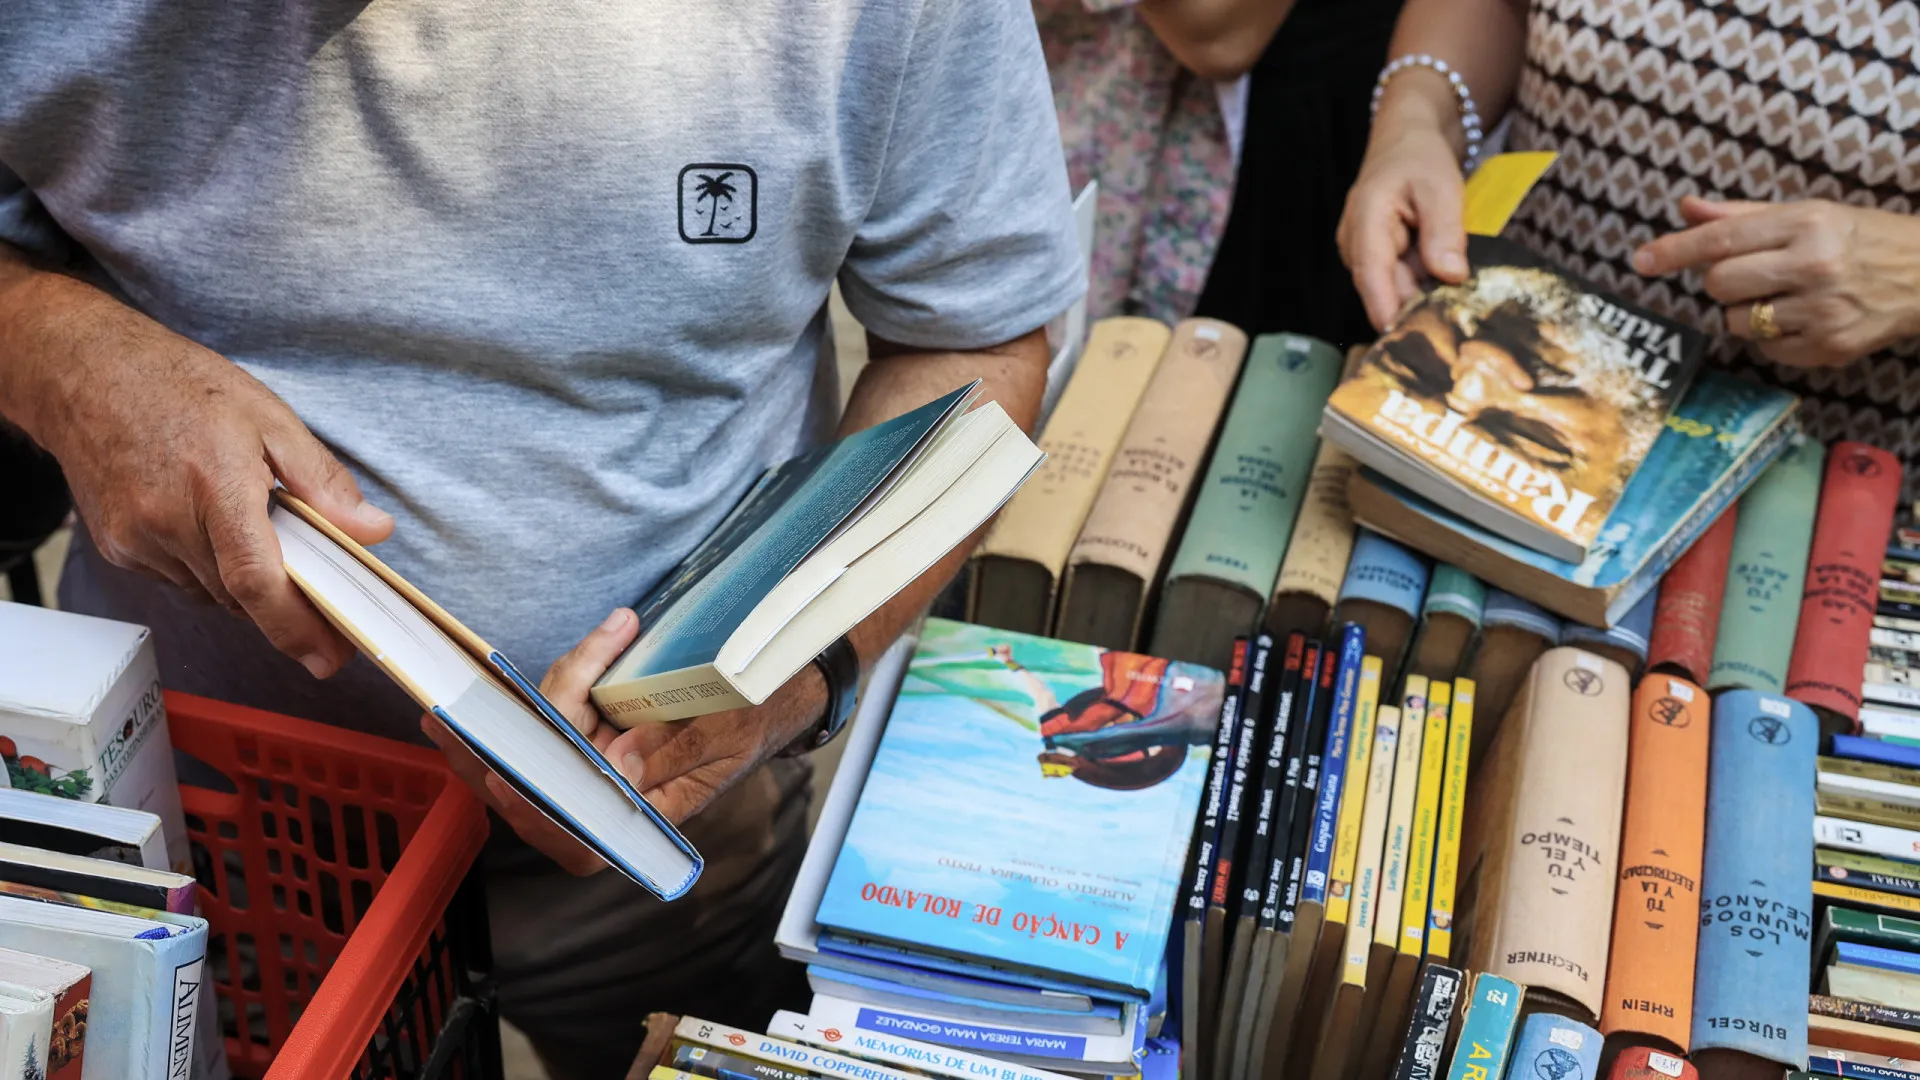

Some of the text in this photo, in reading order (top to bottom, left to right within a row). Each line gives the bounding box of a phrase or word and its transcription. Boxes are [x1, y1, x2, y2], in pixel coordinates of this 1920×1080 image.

[1580, 293, 1684, 361] Vidas
[1376, 389, 1598, 535] Rampa
[648, 687, 695, 707] ALLENDE
[689, 681, 730, 699] ISABEL
[1312, 818, 1331, 854] Gaspar
[1322, 772, 1340, 812] Mariana
[1521, 832, 1602, 864] TIEMPO
[1542, 846, 1587, 872] Y EL
[938, 856, 1136, 902] ALBERTO OLIVEIRA PINTO
[1642, 881, 1676, 900] Y LA
[1355, 867, 1372, 927] Jovens Artistas
[1700, 894, 1811, 926] LEJANOS
[861, 882, 1129, 950] A CANÇÃO DE ROLANDO
[1700, 912, 1810, 941] MUNDOS
[1730, 925, 1781, 945] LOS
[1507, 951, 1589, 982] FLECHTNER
[1621, 998, 1675, 1018] RHEIN
[698, 1024, 714, 1039] 25
[758, 1041, 809, 1063] DAVID
[875, 1014, 1067, 1051] MARIA TERESA MAIA GONZALEZ
[1707, 1017, 1787, 1041] BÜRGEL
[753, 1065, 785, 1079] Valer
[854, 1035, 942, 1068] MEMÓRIAS
[946, 1054, 966, 1071] DE
[969, 1060, 998, 1080] UM
[1851, 1064, 1875, 1073] PONS
[1877, 1068, 1906, 1078] PALAO
